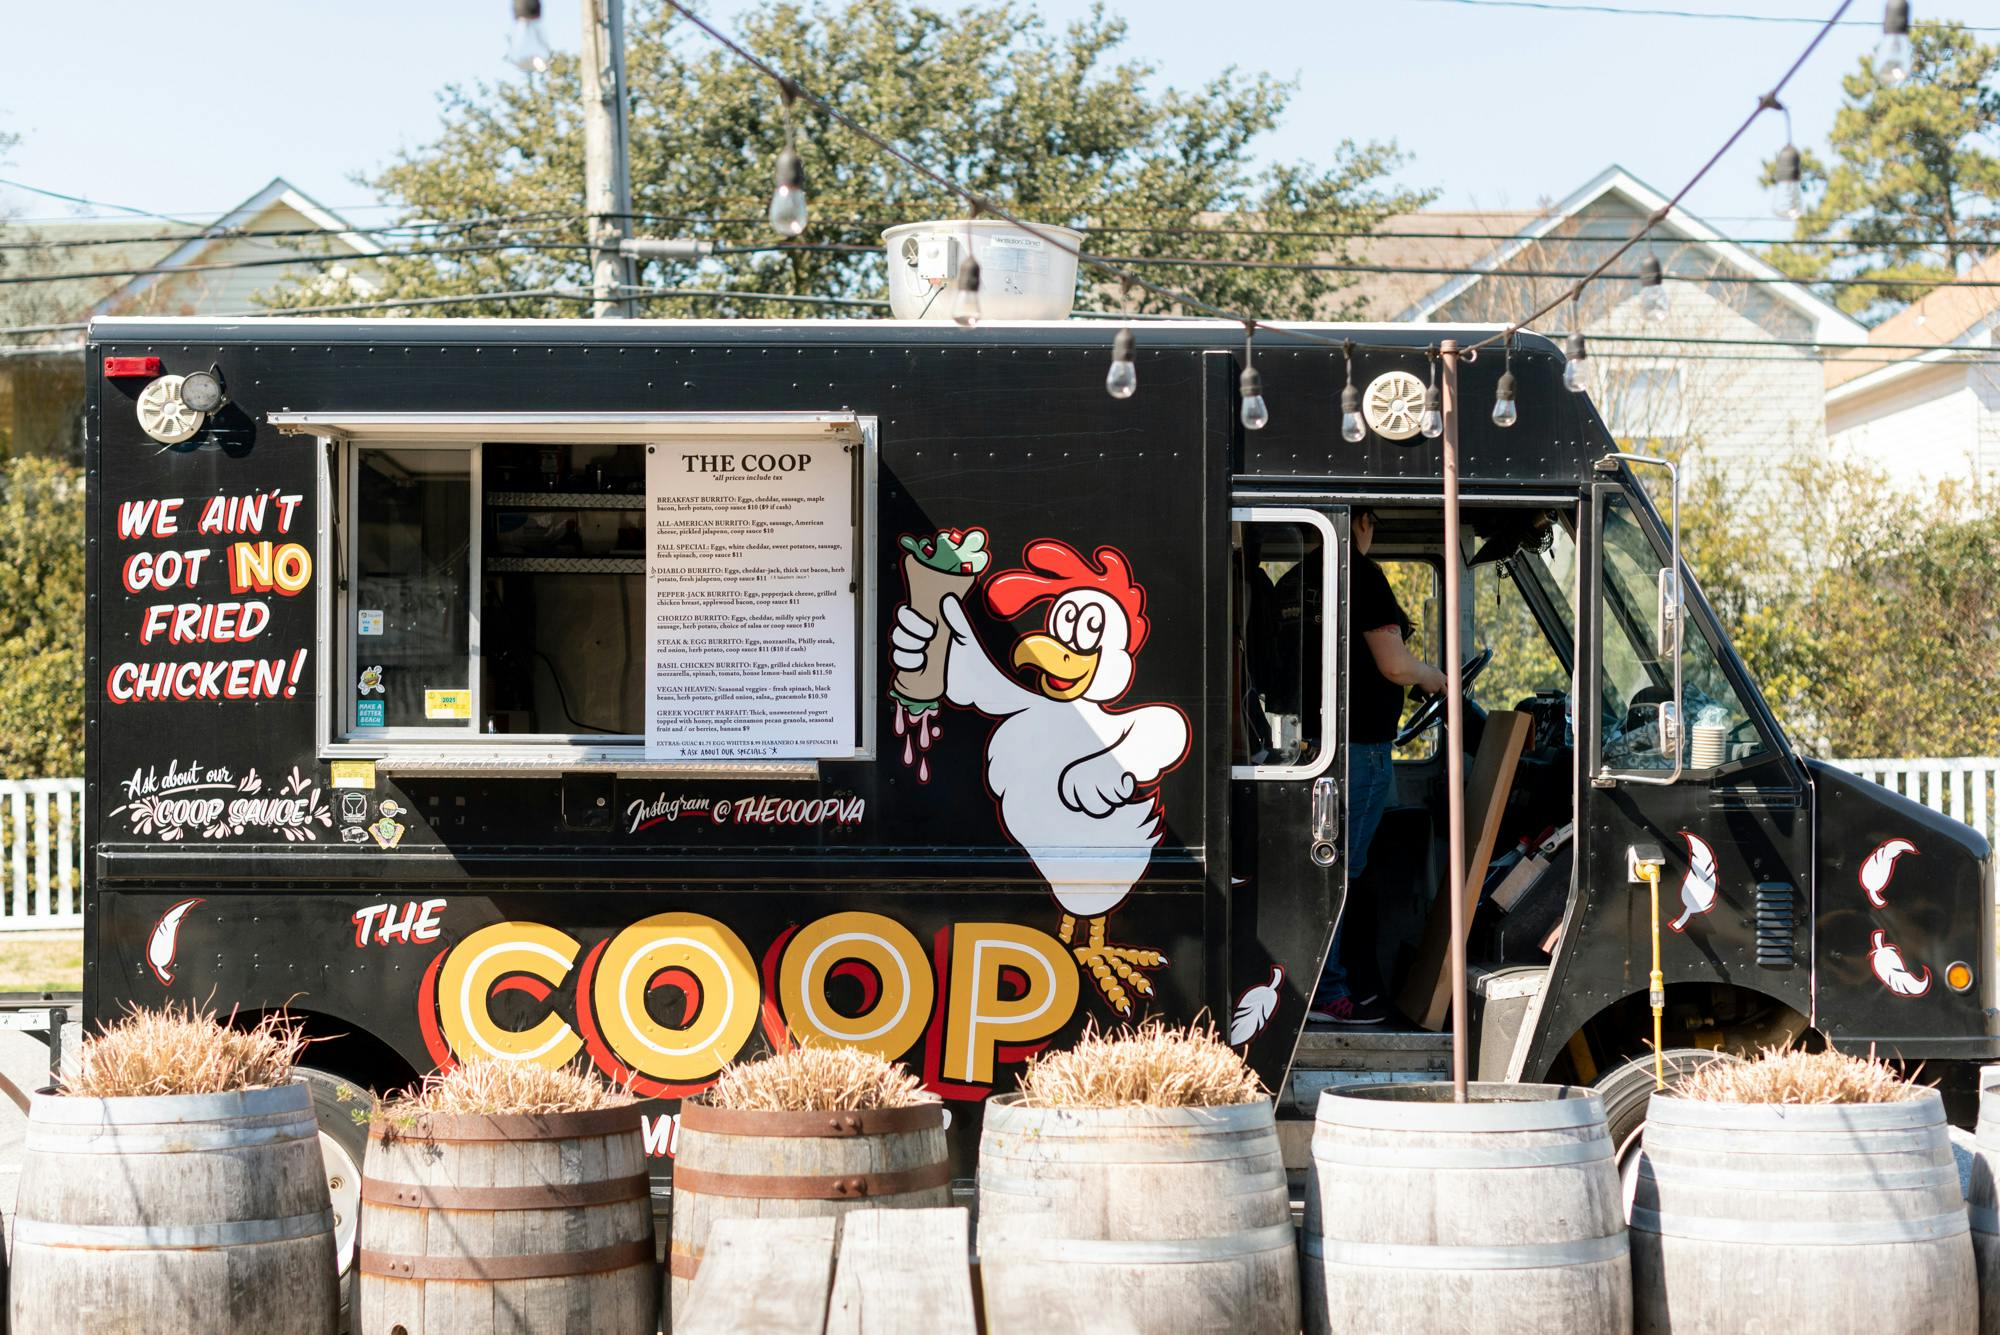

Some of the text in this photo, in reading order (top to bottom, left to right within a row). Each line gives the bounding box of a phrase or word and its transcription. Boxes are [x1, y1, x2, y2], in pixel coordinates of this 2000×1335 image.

[682, 454, 812, 472] THE COOP
[725, 474, 745, 482] prices
[118, 488, 303, 540] WE AIN'T
[122, 541, 312, 597] GOT NO
[140, 601, 270, 646] FRIED
[657, 614, 693, 622] CHORIZO
[775, 614, 794, 622] mildly
[795, 614, 811, 622] spicy
[812, 614, 826, 622] pork
[107, 648, 308, 704] CHICKEN!
[714, 693, 735, 701] grilled
[775, 693, 807, 701] guacamole
[121, 759, 234, 800] Ask about our
[152, 787, 321, 828] COOP SAUCE!
[627, 792, 867, 834] Instagram @ THECOOPVA
[352, 898, 448, 948] THE
[418, 911, 1080, 1100] COOP
